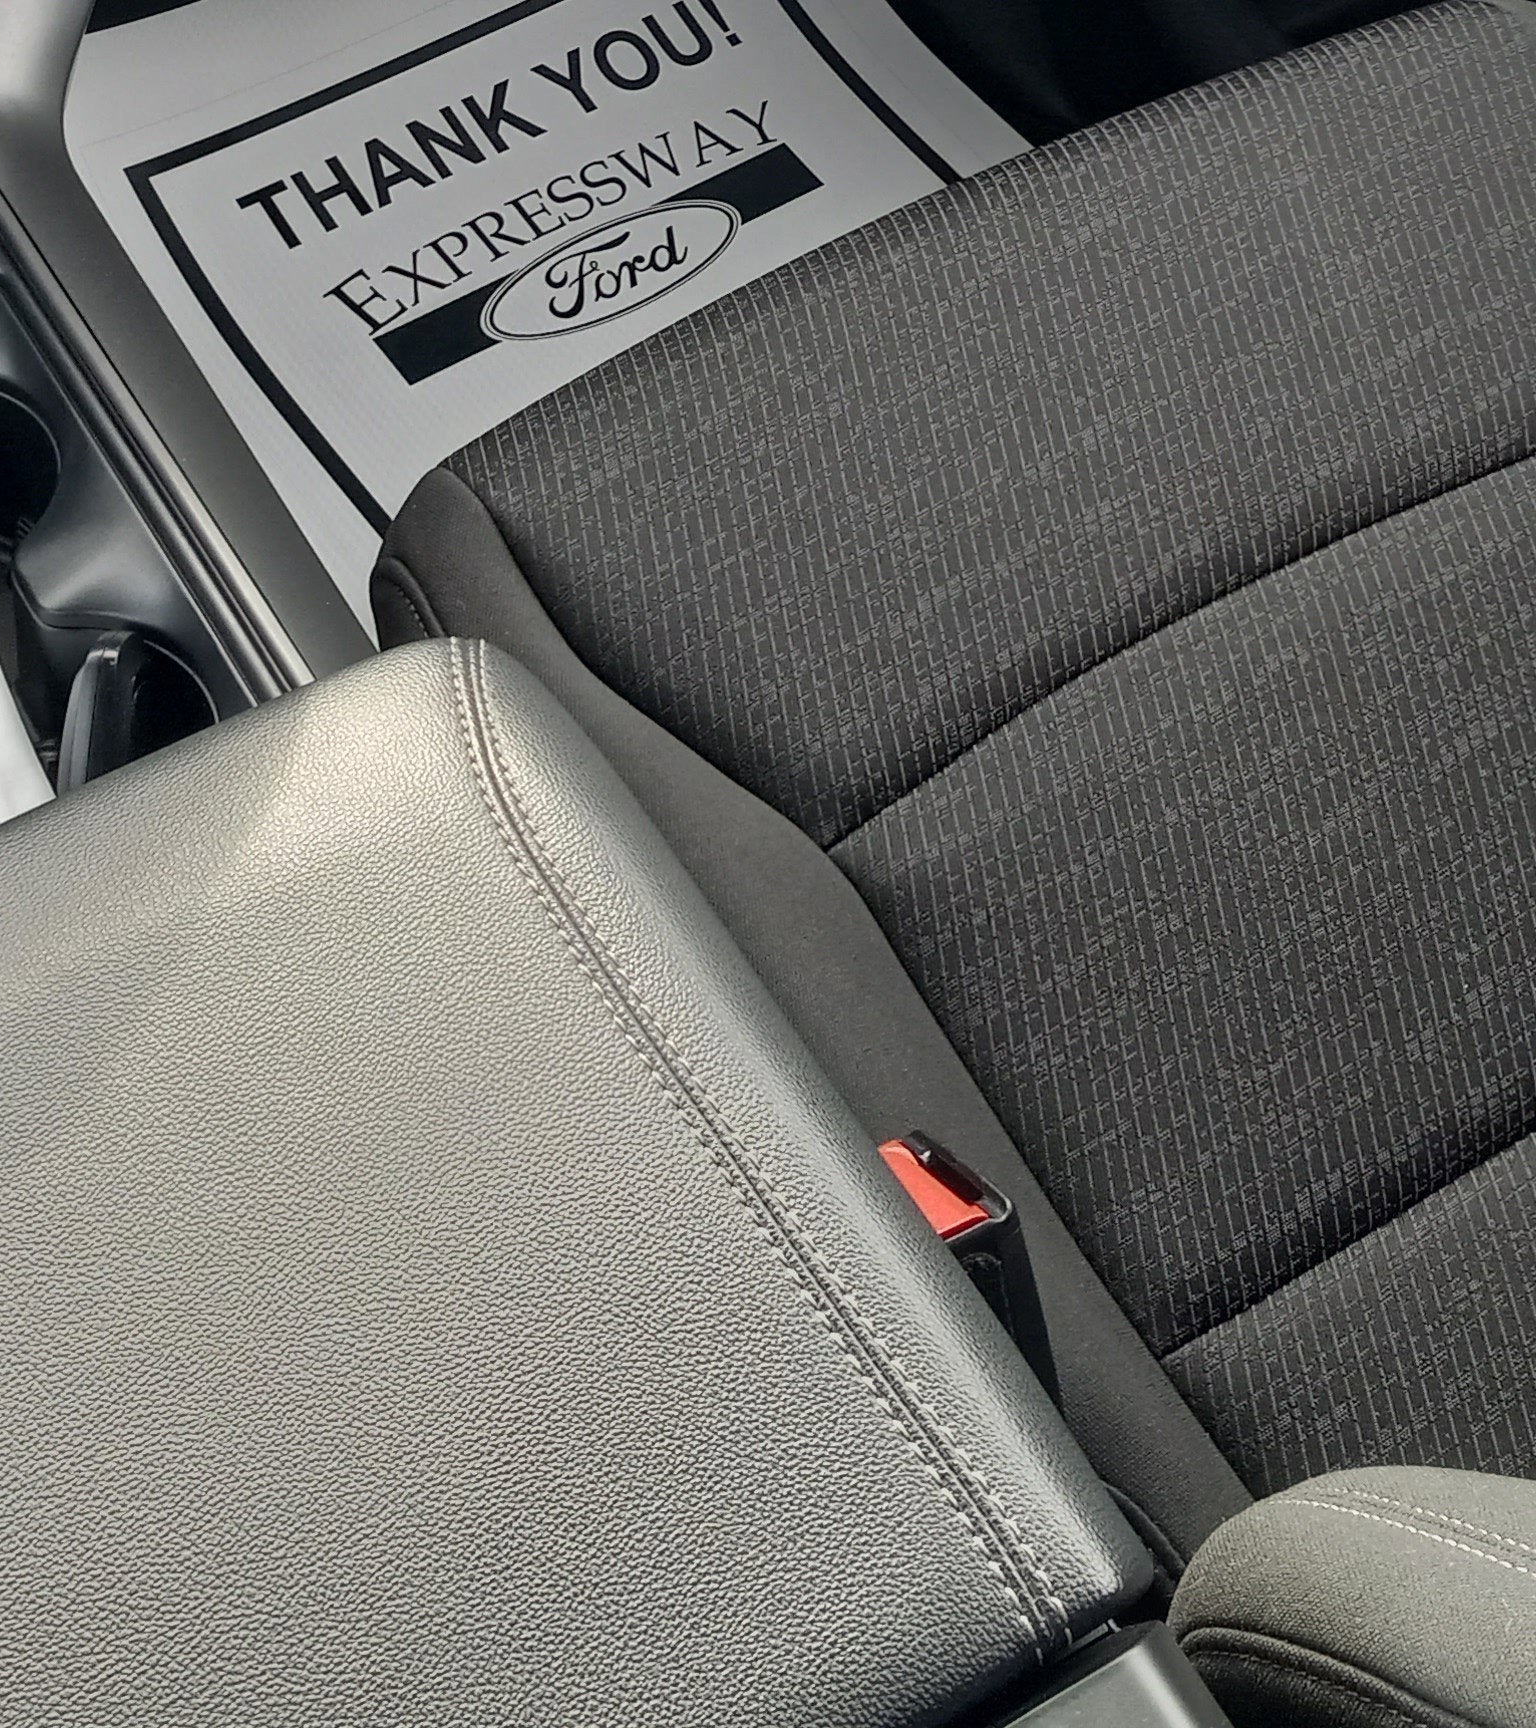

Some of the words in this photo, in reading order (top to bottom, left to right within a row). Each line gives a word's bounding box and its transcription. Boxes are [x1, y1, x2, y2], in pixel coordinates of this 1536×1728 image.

[234, 78, 546, 251] THANK
[321, 99, 782, 337] EXPRESSWAY
[544, 224, 690, 322] Ford
